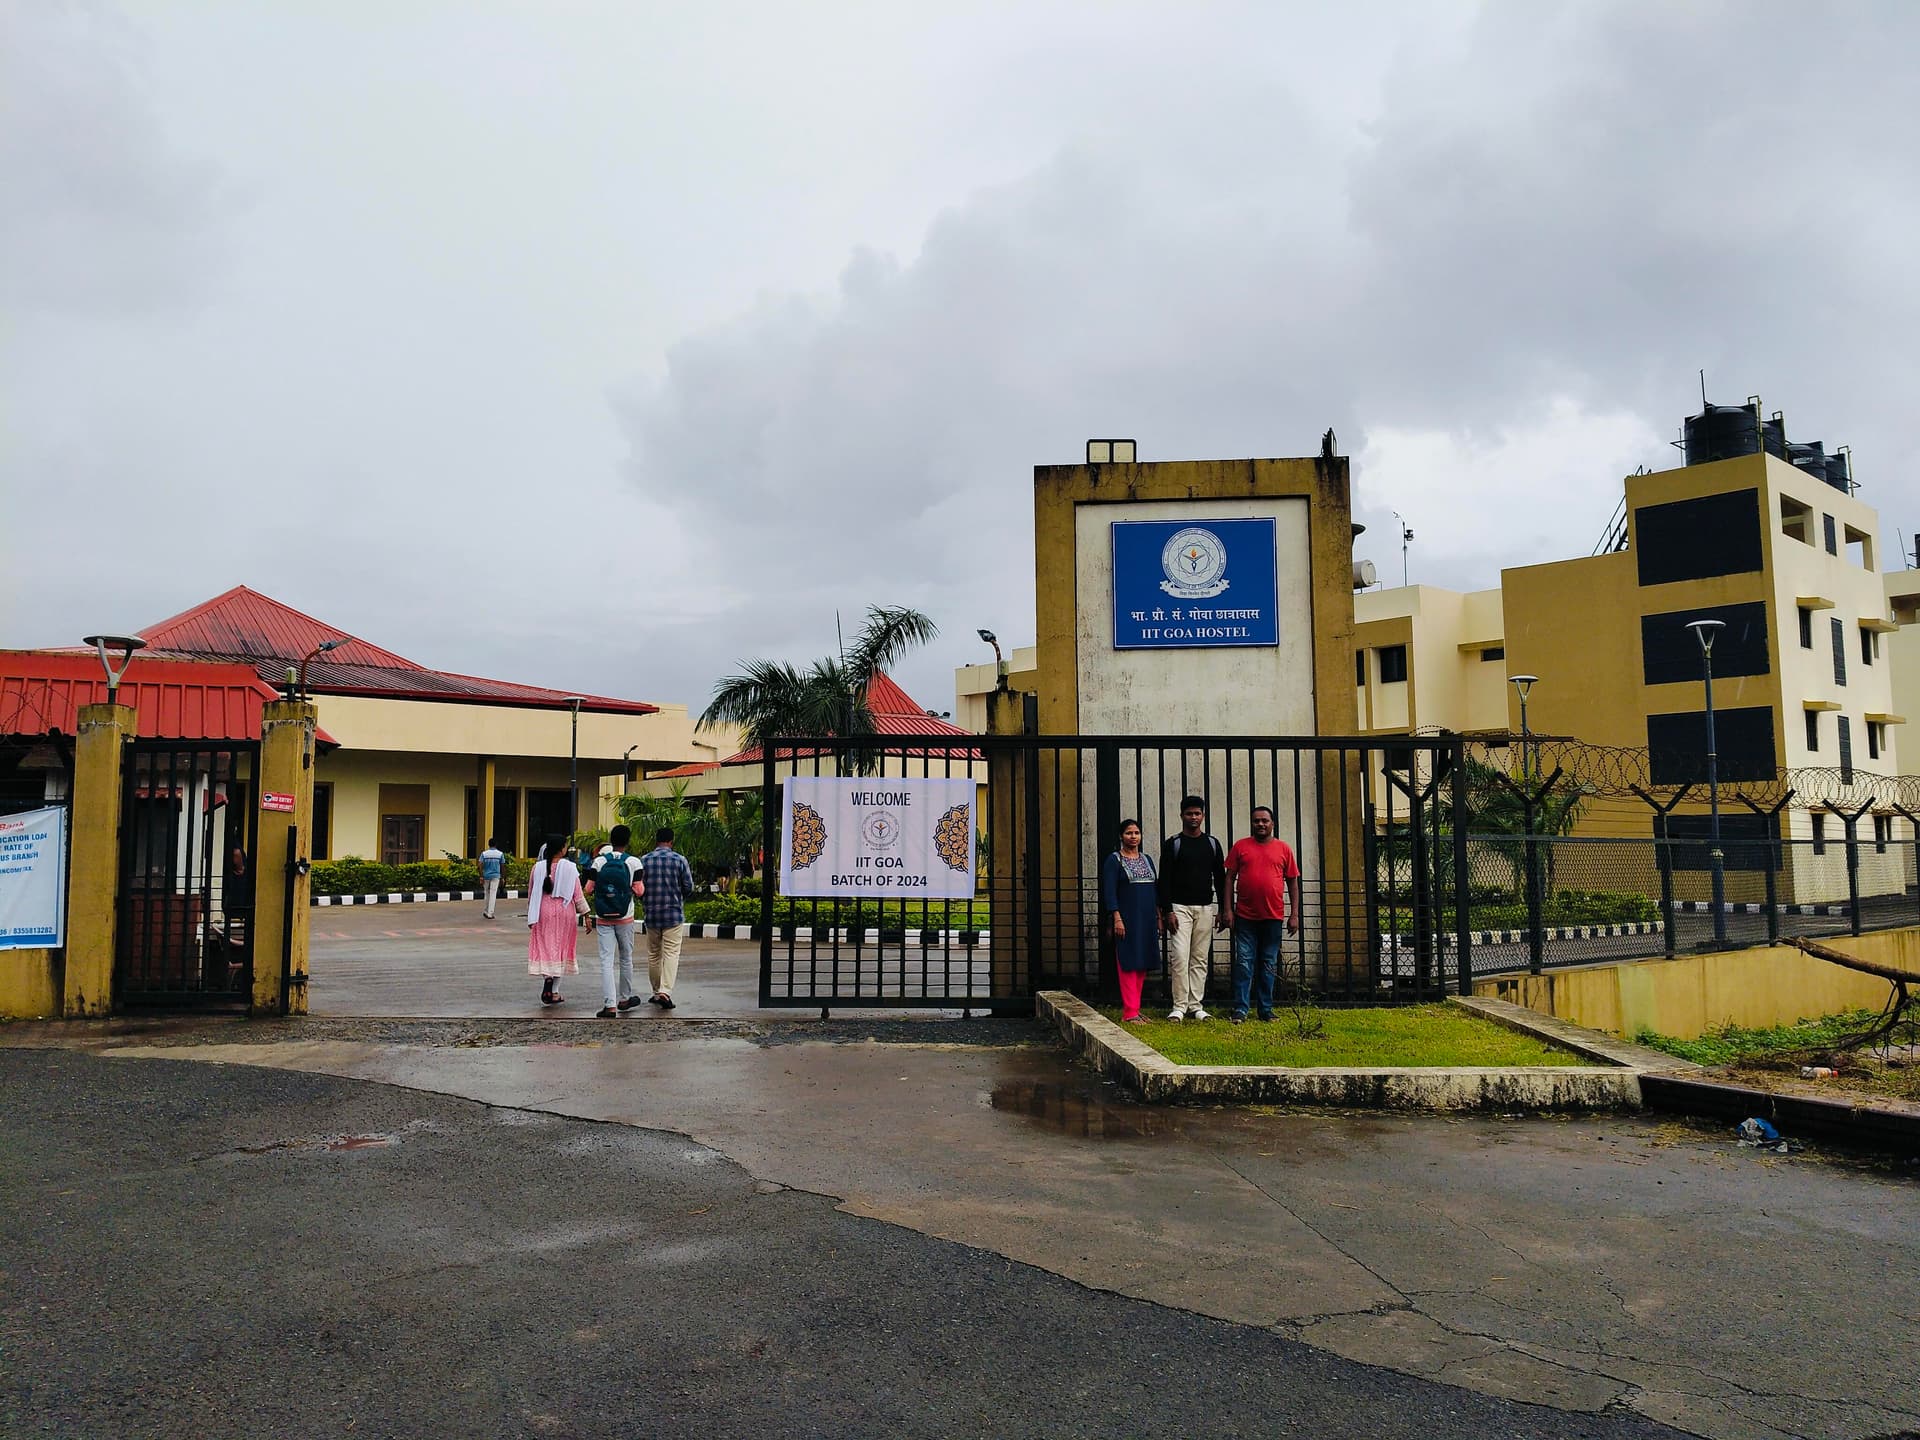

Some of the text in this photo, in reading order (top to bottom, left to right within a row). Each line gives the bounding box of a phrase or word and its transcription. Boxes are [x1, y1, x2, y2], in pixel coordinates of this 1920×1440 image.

[1188, 606, 1213, 620] गोवा
[1215, 609, 1260, 620] छात्रावास
[1142, 626, 1250, 639] IIT GOA HOSTEL
[851, 791, 911, 806] WELCOME
[4, 843, 22, 851] RATE
[855, 857, 904, 869] IIT GOA
[831, 875, 928, 887] BATCH OF 2024
